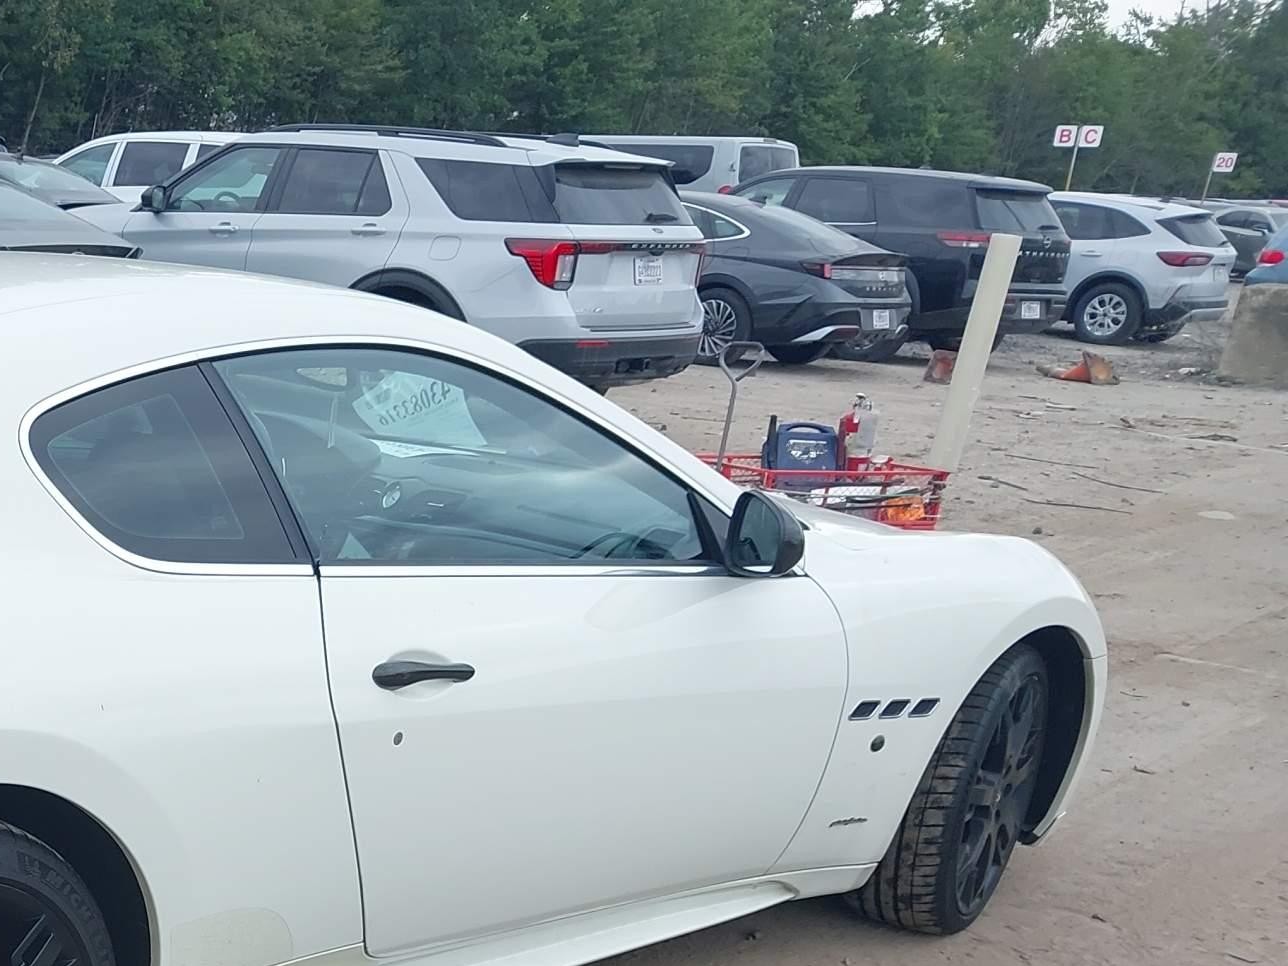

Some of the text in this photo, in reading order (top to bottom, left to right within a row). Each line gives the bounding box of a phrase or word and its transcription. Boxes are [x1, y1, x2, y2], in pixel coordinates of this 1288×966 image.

[1058, 128, 1073, 144] B
[1083, 128, 1099, 145] C
[1215, 156, 1235, 168] 20
